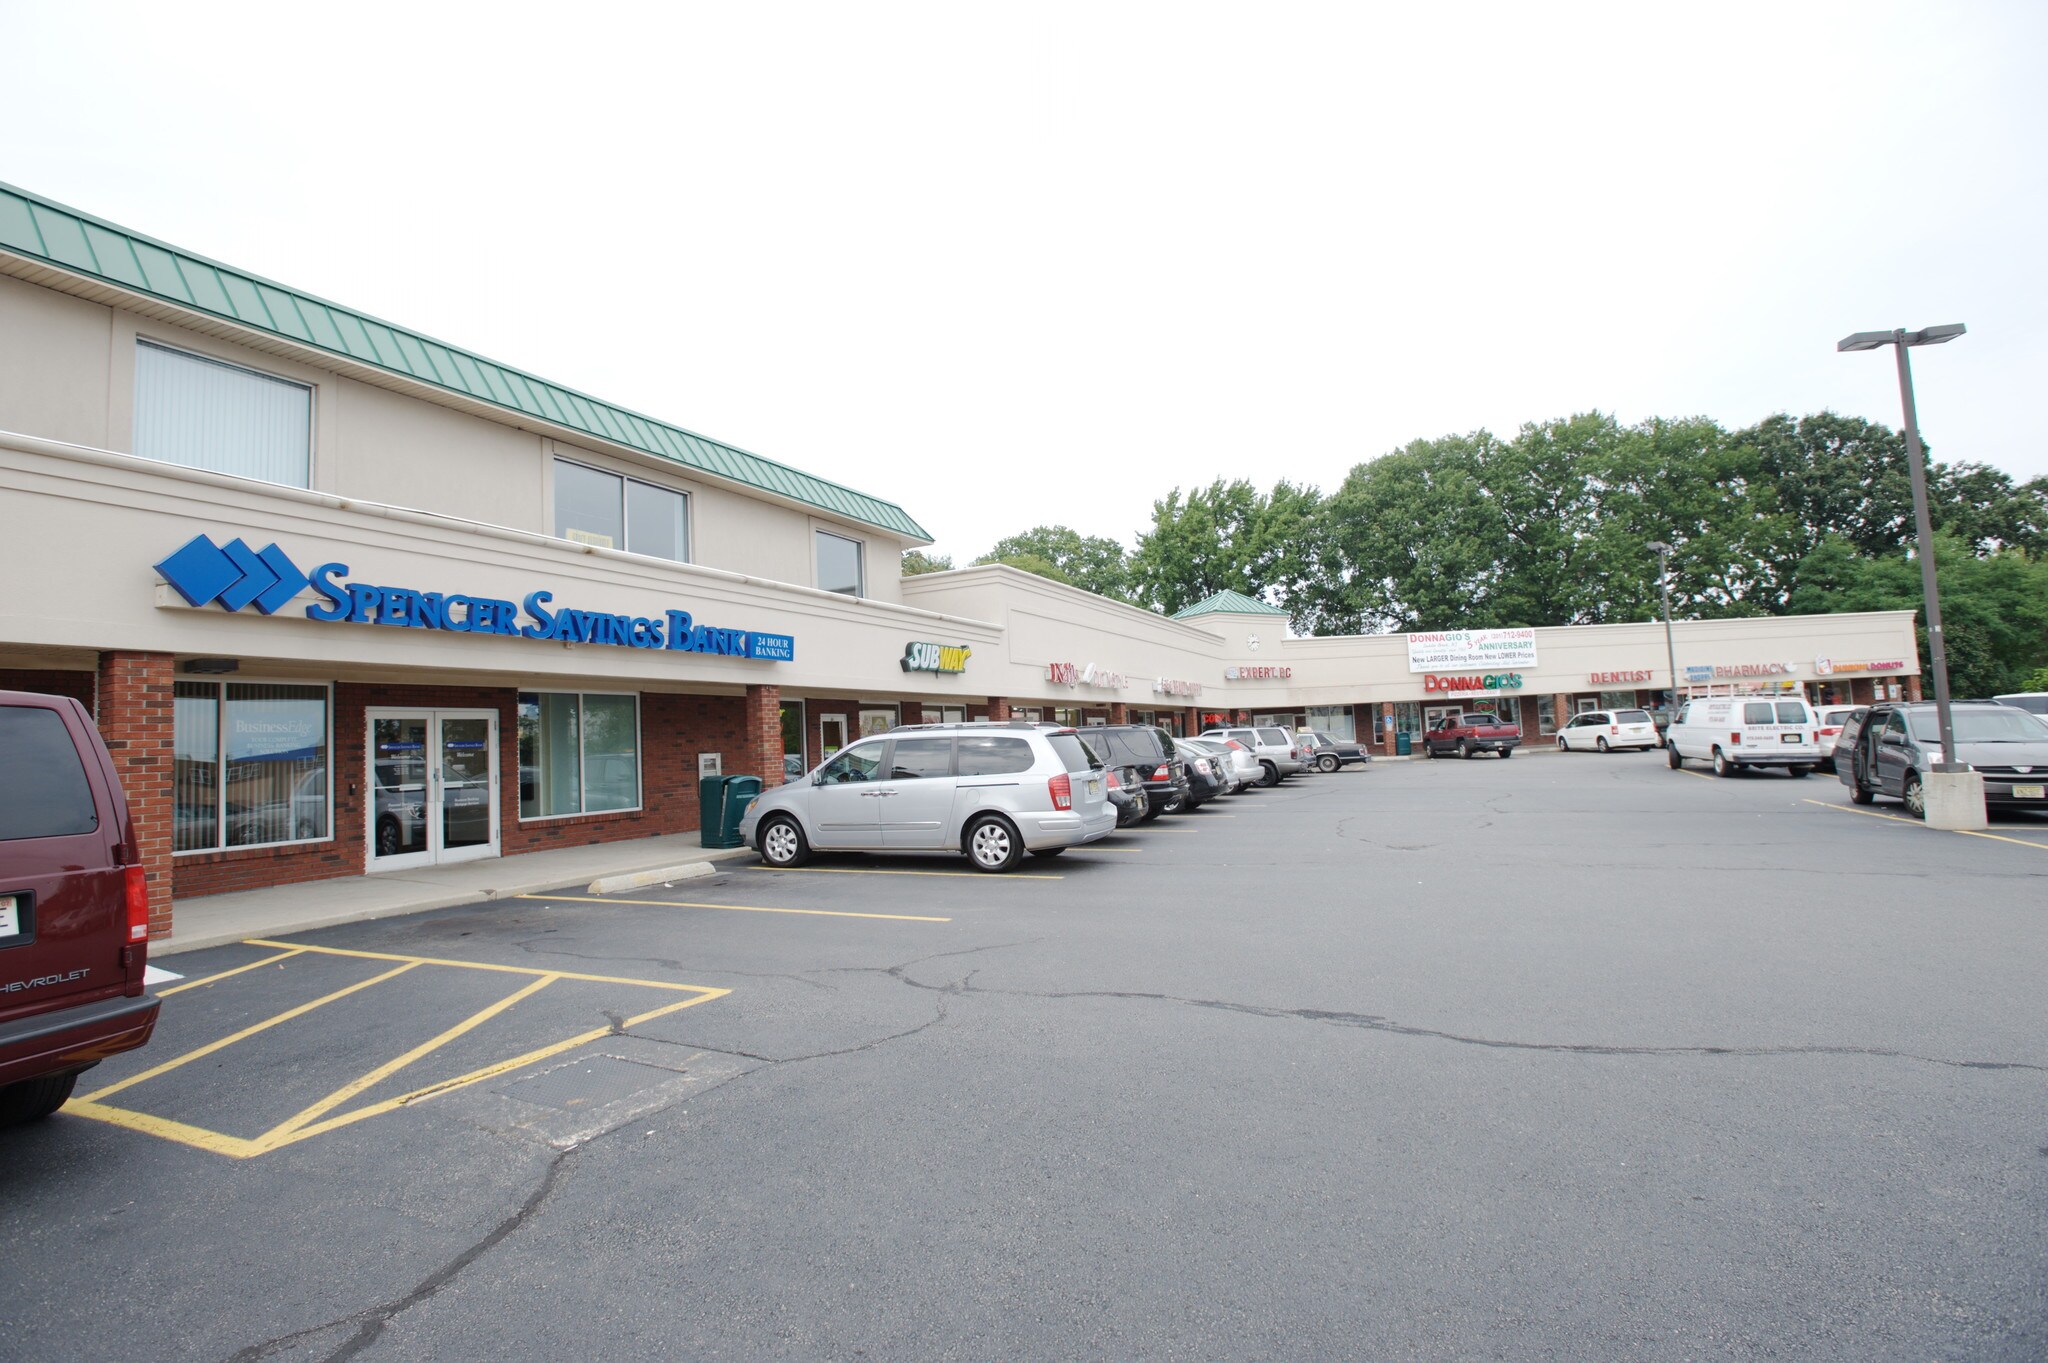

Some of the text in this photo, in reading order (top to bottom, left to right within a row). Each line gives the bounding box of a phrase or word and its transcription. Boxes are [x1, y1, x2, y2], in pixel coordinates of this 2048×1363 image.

[306, 562, 746, 658] SPENCER SAVINGS BANK
[1409, 633, 1471, 643] DONNAGIO'S
[1503, 630, 1533, 639] 712-9400
[757, 636, 789, 649] 24 HOUR
[1478, 641, 1533, 650] ANNIVERSARY
[755, 646, 790, 658] BANKING
[907, 642, 972, 671] SUBWAY
[1517, 651, 1535, 659] Prices
[1715, 663, 1786, 677] PHARMACY
[1870, 660, 1904, 670] DONUTS
[1239, 667, 1276, 679] EXPERT
[1591, 670, 1654, 684] DENTIST
[1424, 672, 1523, 693] DONNAGIO'S
[1474, 703, 1496, 711] OPEN
